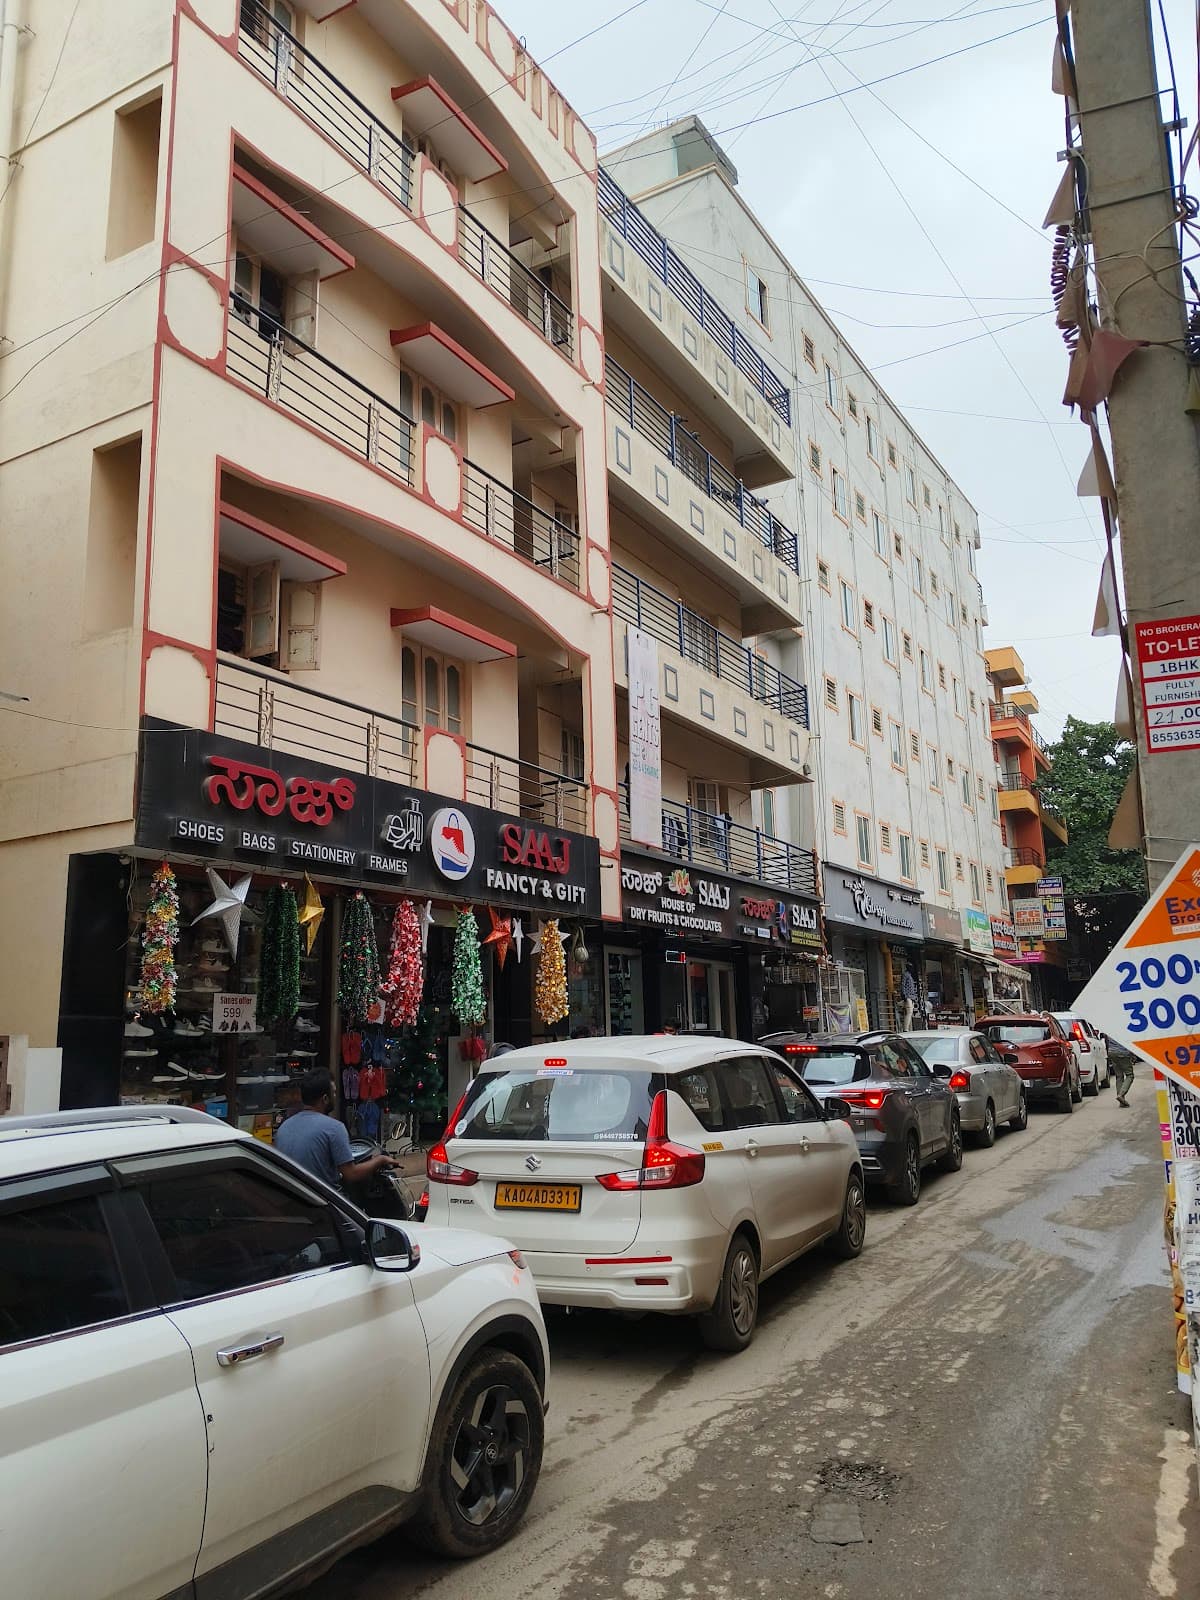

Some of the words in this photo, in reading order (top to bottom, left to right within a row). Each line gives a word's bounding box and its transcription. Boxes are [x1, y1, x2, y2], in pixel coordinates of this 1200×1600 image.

[1139, 628, 1154, 637] NO
[1160, 660, 1199, 674] 1BHK
[1166, 680, 1195, 690] FULLY
[208, 755, 357, 826] ಸಾಜ್
[178, 820, 225, 843] SHOES
[242, 831, 276, 851] BAGS
[291, 840, 357, 866] STATIONERY
[502, 823, 572, 876] SAAJ
[370, 855, 408, 873] FRAMES
[486, 867, 538, 896] FANCY
[542, 880, 553, 900] &
[556, 883, 586, 905] GIFT
[621, 867, 663, 895] ಸಾಜ್
[660, 896, 685, 912] HOUSE
[686, 901, 696, 914] OF
[698, 879, 731, 911] SAAJ
[630, 906, 646, 920] DRY
[647, 909, 673, 925] FRUITS
[673, 914, 680, 926] &
[680, 915, 723, 933] CHOCOLATES
[792, 904, 817, 930] SAAJ
[503, 1187, 579, 1206] KA04AD3311
